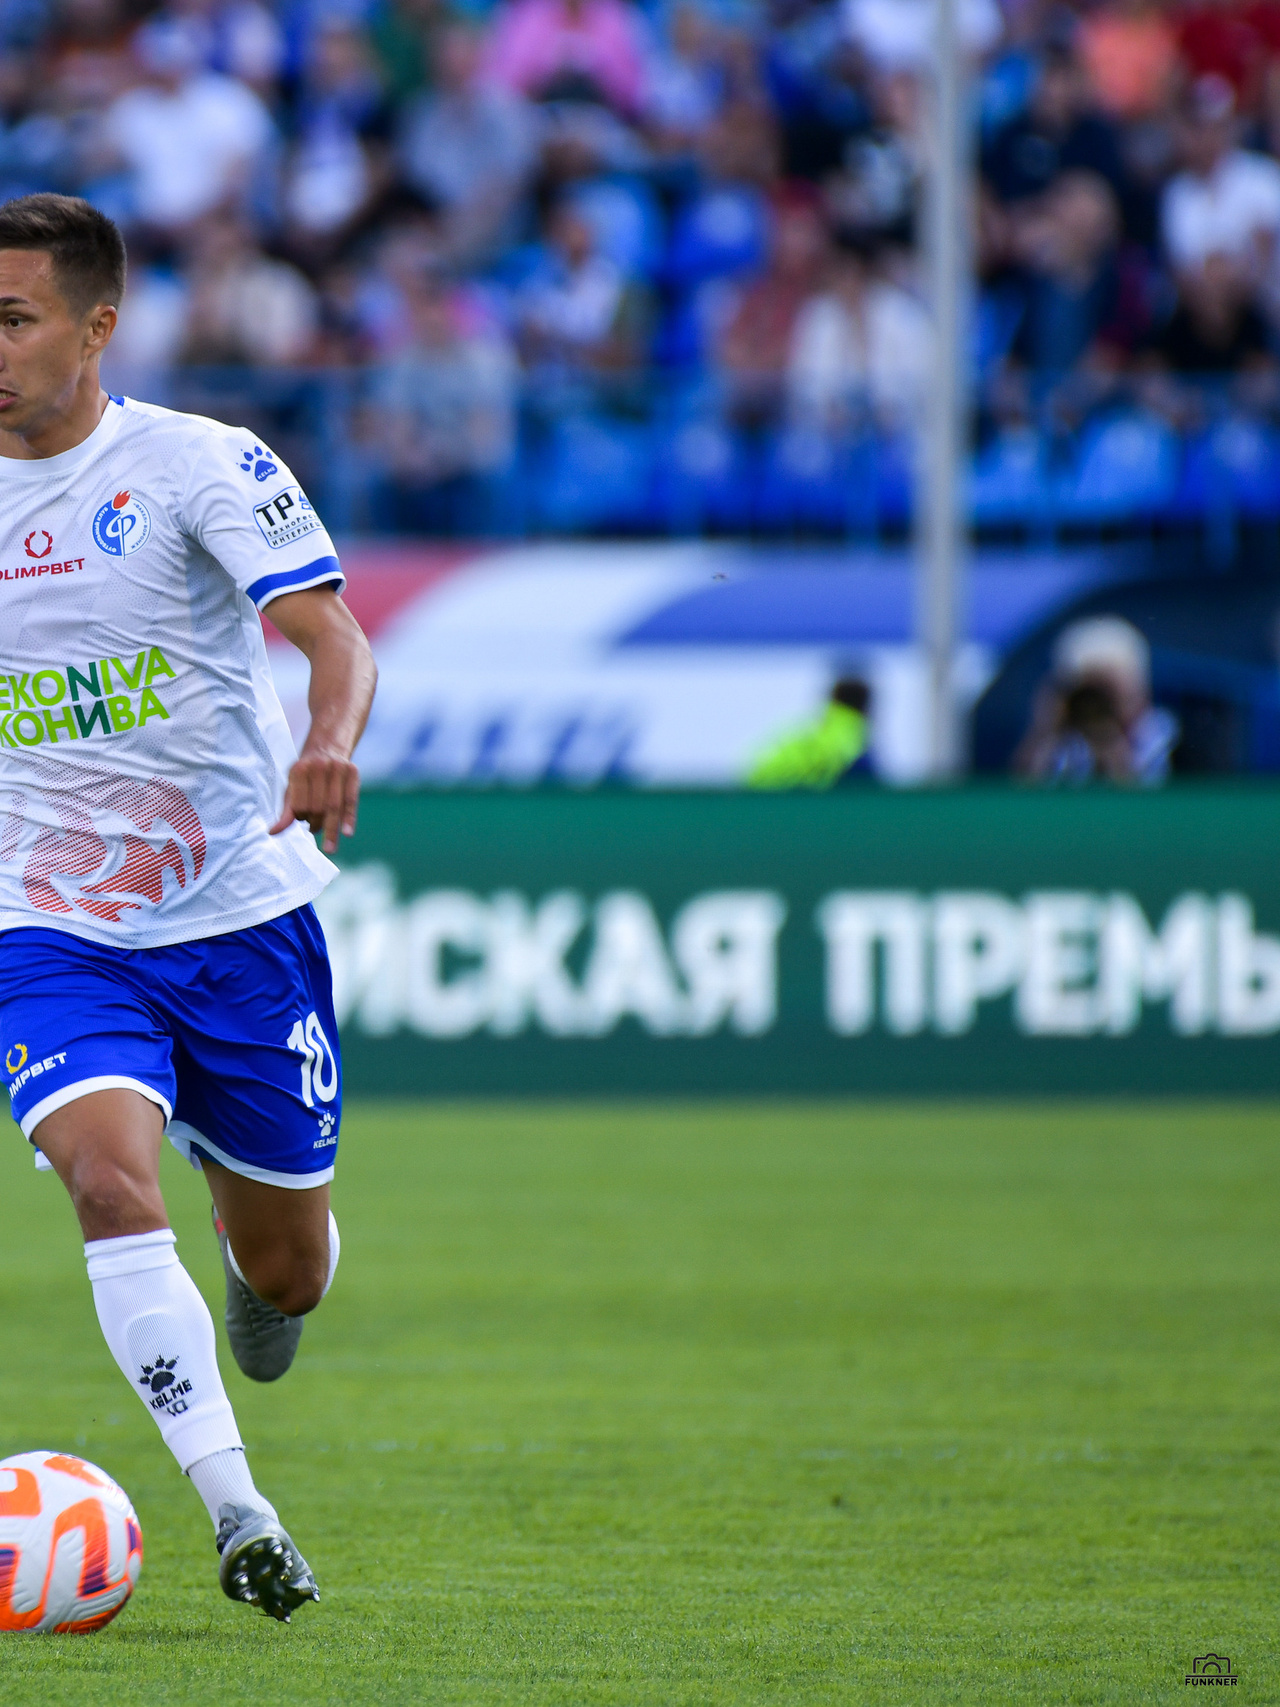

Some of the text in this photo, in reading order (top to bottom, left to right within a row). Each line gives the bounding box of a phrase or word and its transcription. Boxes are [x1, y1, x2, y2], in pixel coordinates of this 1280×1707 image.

[257, 466, 276, 480] KELME
[286, 1011, 338, 1108] 10
[313, 1136, 338, 1149] KELME
[149, 1379, 193, 1410] KELME
